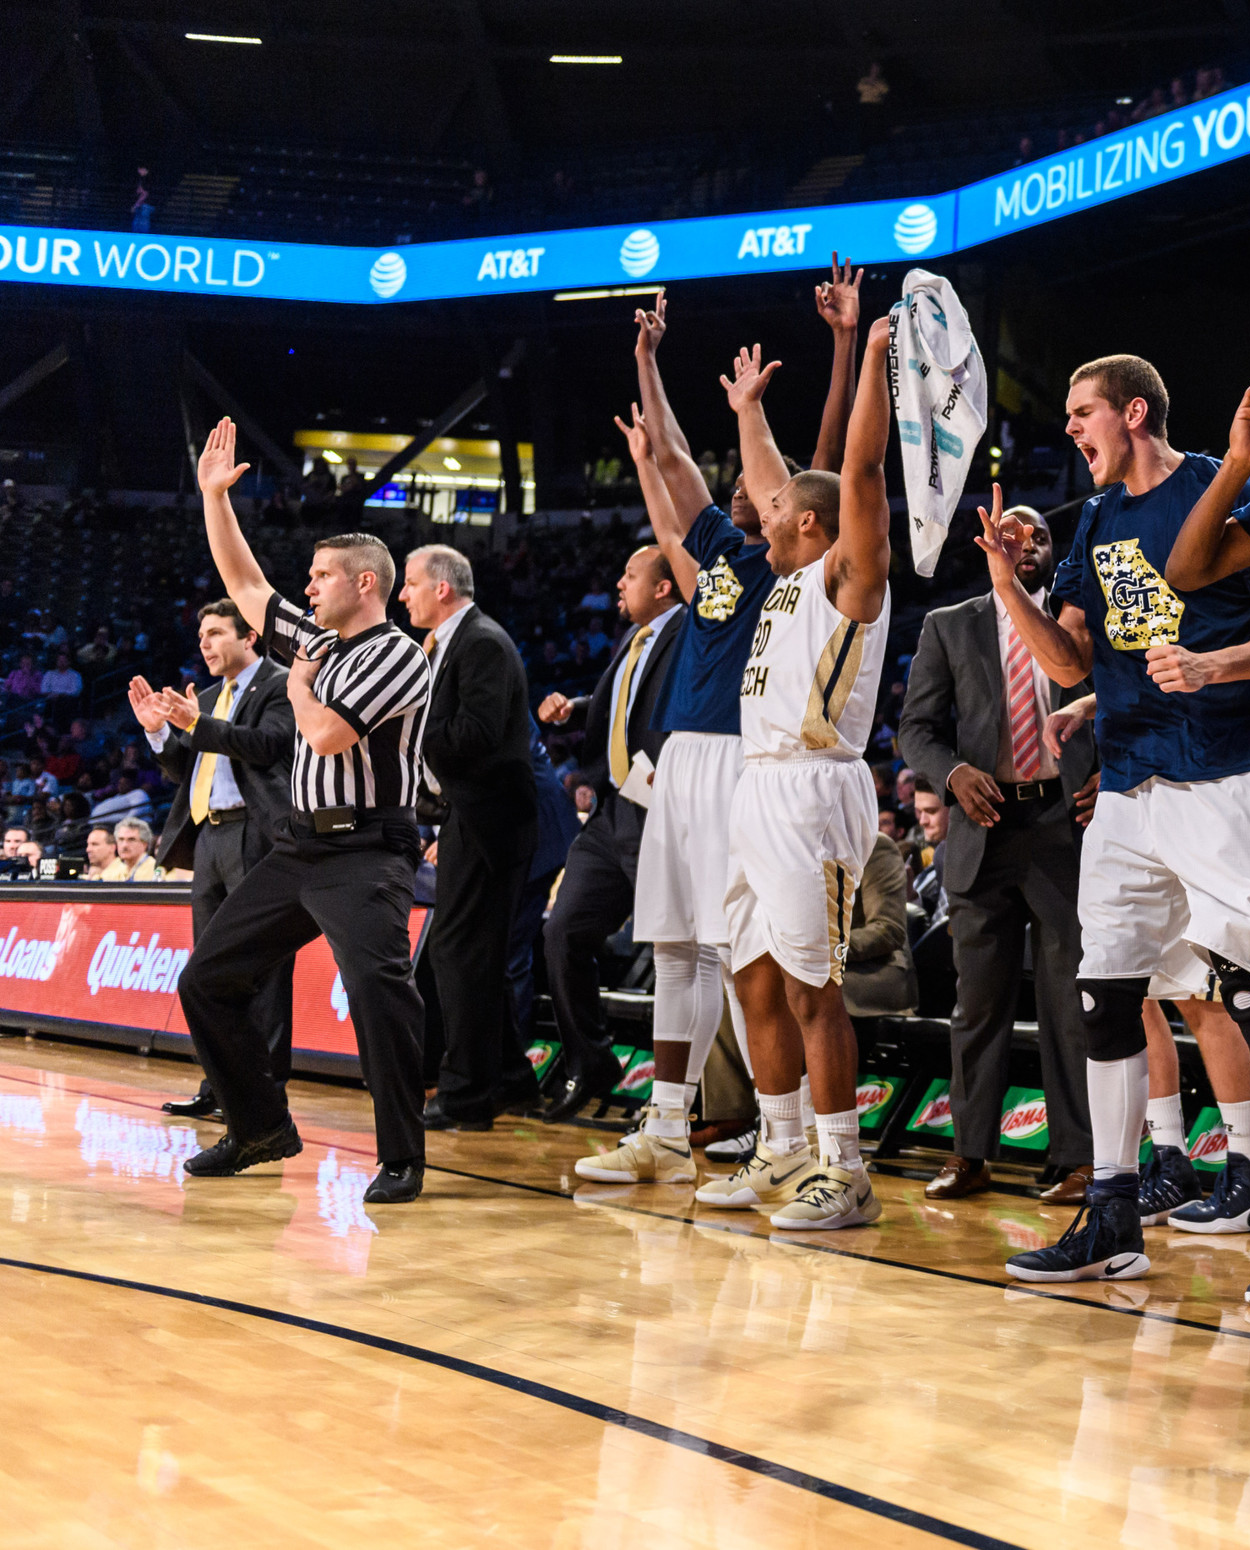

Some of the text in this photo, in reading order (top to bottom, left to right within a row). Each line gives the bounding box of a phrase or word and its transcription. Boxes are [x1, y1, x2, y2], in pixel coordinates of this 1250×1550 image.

[994, 121, 1186, 227] MOBILIZING
[737, 222, 814, 260] AT&T
[476, 246, 546, 282] AT&T
[1110, 577, 1161, 615] GT
[86, 929, 190, 996] Quicken
